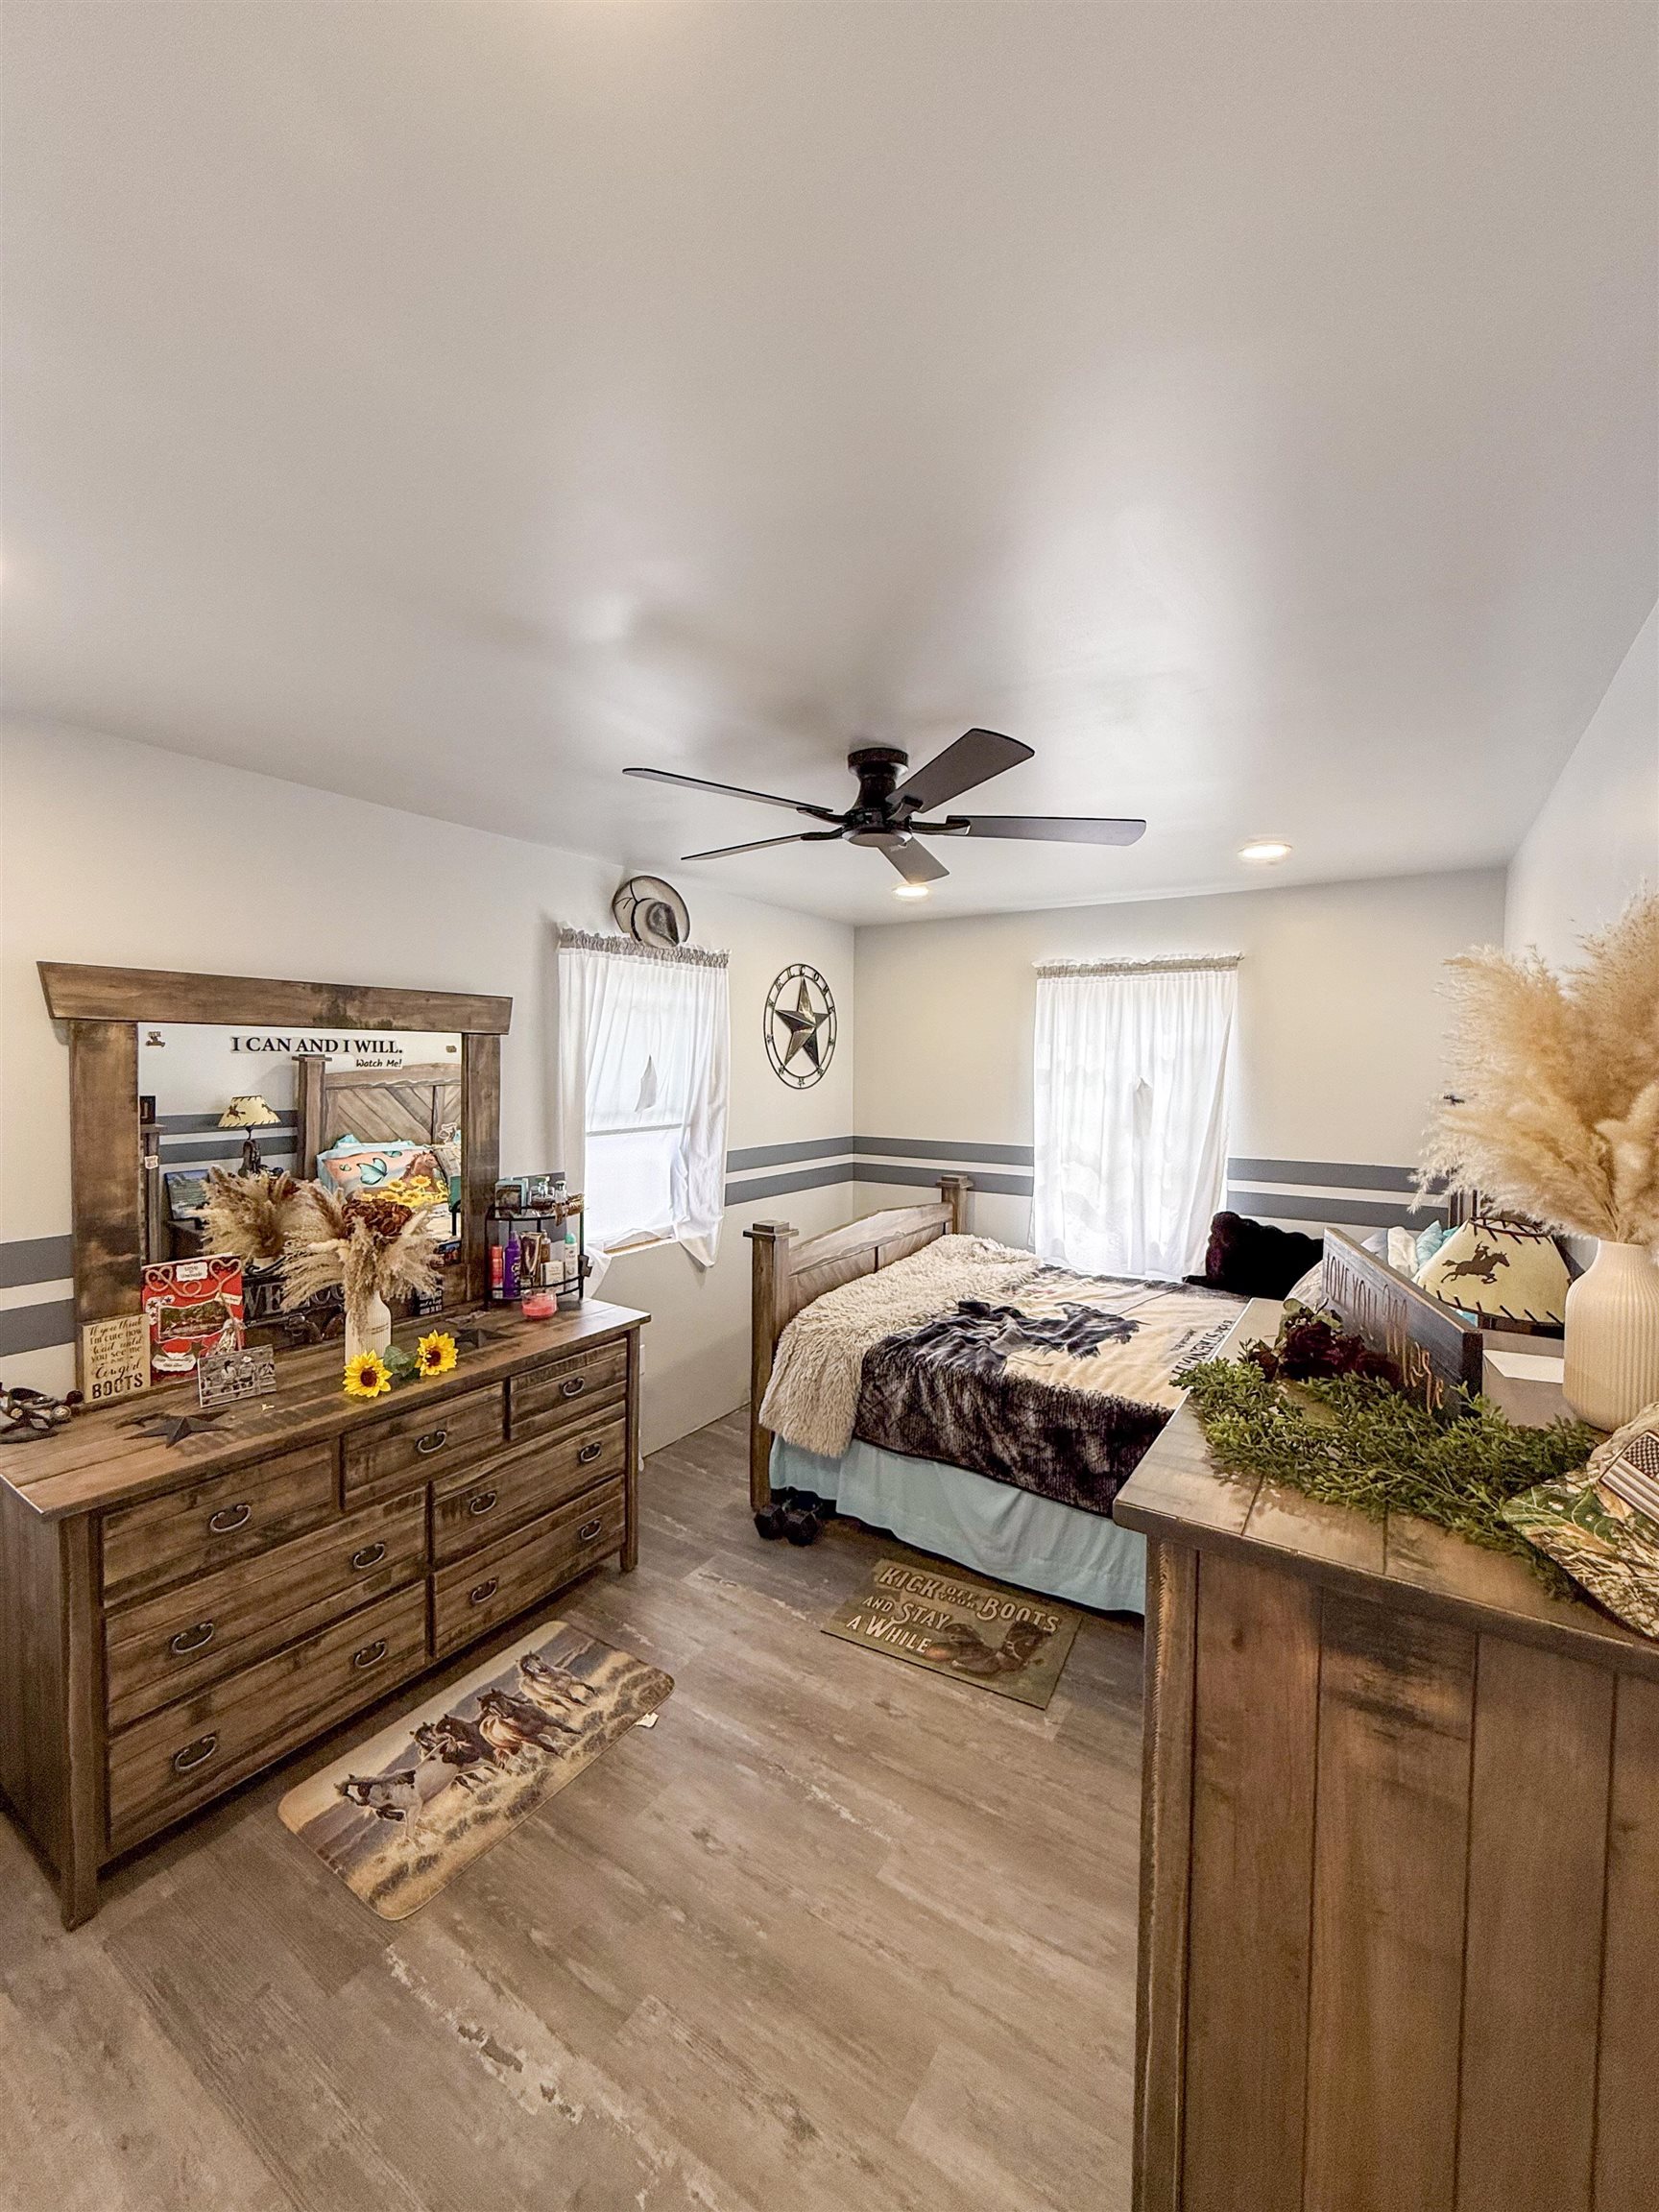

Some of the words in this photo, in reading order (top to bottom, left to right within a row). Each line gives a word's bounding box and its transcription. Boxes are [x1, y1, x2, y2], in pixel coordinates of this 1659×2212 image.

[232, 1037, 240, 1051] I
[246, 1037, 292, 1052] CAN
[296, 1038, 339, 1053] AND
[343, 1039, 349, 1053] I
[353, 1040, 403, 1054] WILL.
[355, 1059, 383, 1068] Watch
[386, 1059, 402, 1068] Me!
[1325, 1252, 1350, 1308] LOVE
[1352, 1274, 1378, 1340] YOU
[100, 1326, 116, 1336] you
[105, 1333, 123, 1342] cute
[126, 1329, 142, 1337] now
[91, 1354, 108, 1363] you
[110, 1349, 127, 1358] see
[92, 1372, 143, 1400] BOOTS
[878, 1566, 942, 1599] KICK
[946, 1585, 976, 1601] OFF
[976, 1597, 1061, 1633] BOOTS
[862, 1596, 894, 1613] AND
[891, 1602, 951, 1631] STAY
[846, 1615, 862, 1630] A
[865, 1615, 932, 1654] WHILE
